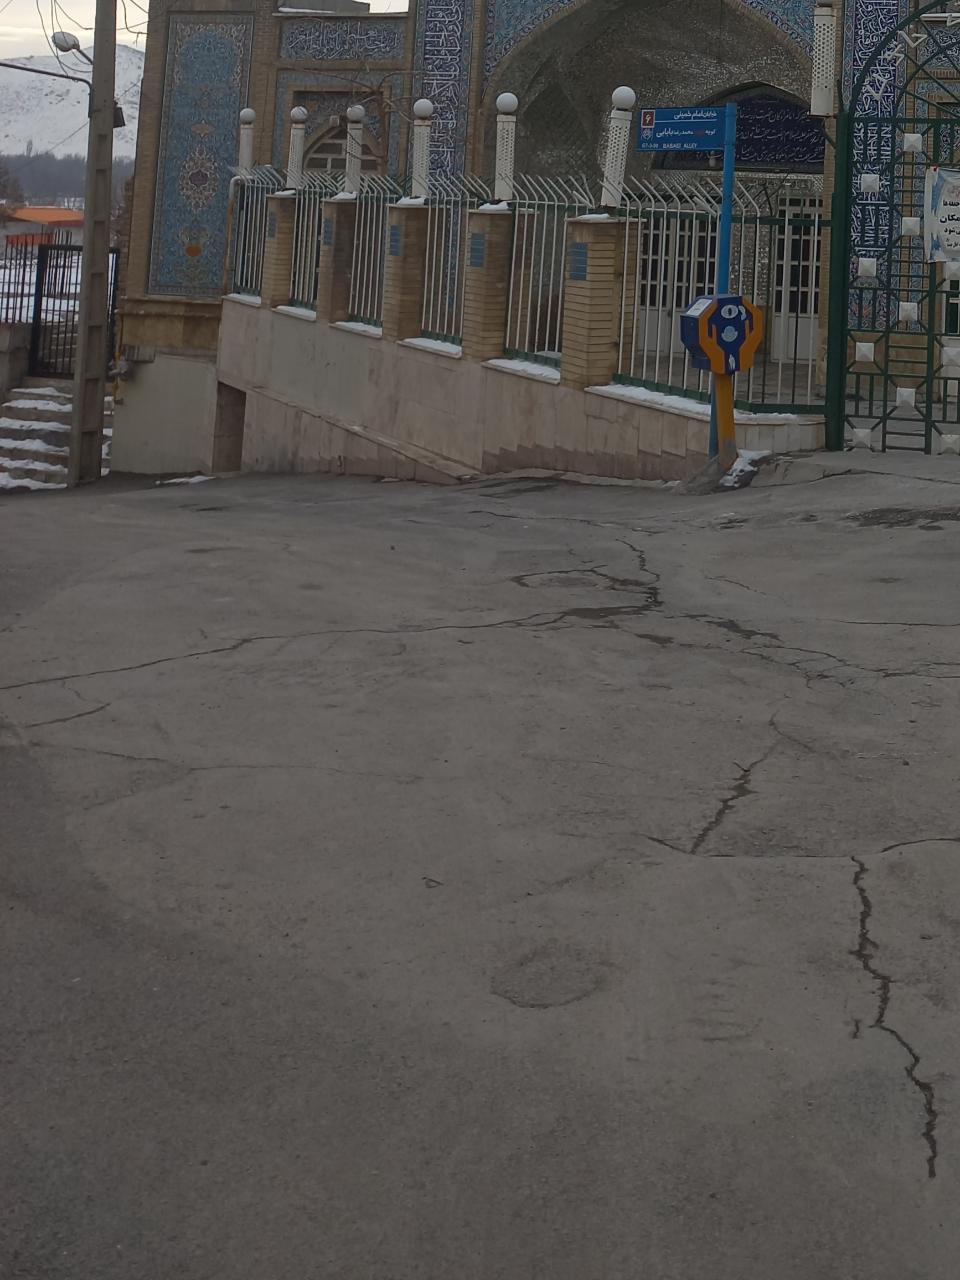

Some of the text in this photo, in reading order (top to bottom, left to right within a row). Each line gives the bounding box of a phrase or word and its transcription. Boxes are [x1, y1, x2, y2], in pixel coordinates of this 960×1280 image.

[673, 109, 692, 120] خمینی
[655, 127, 674, 138] بابایی
[939, 213, 960, 223] مکان
